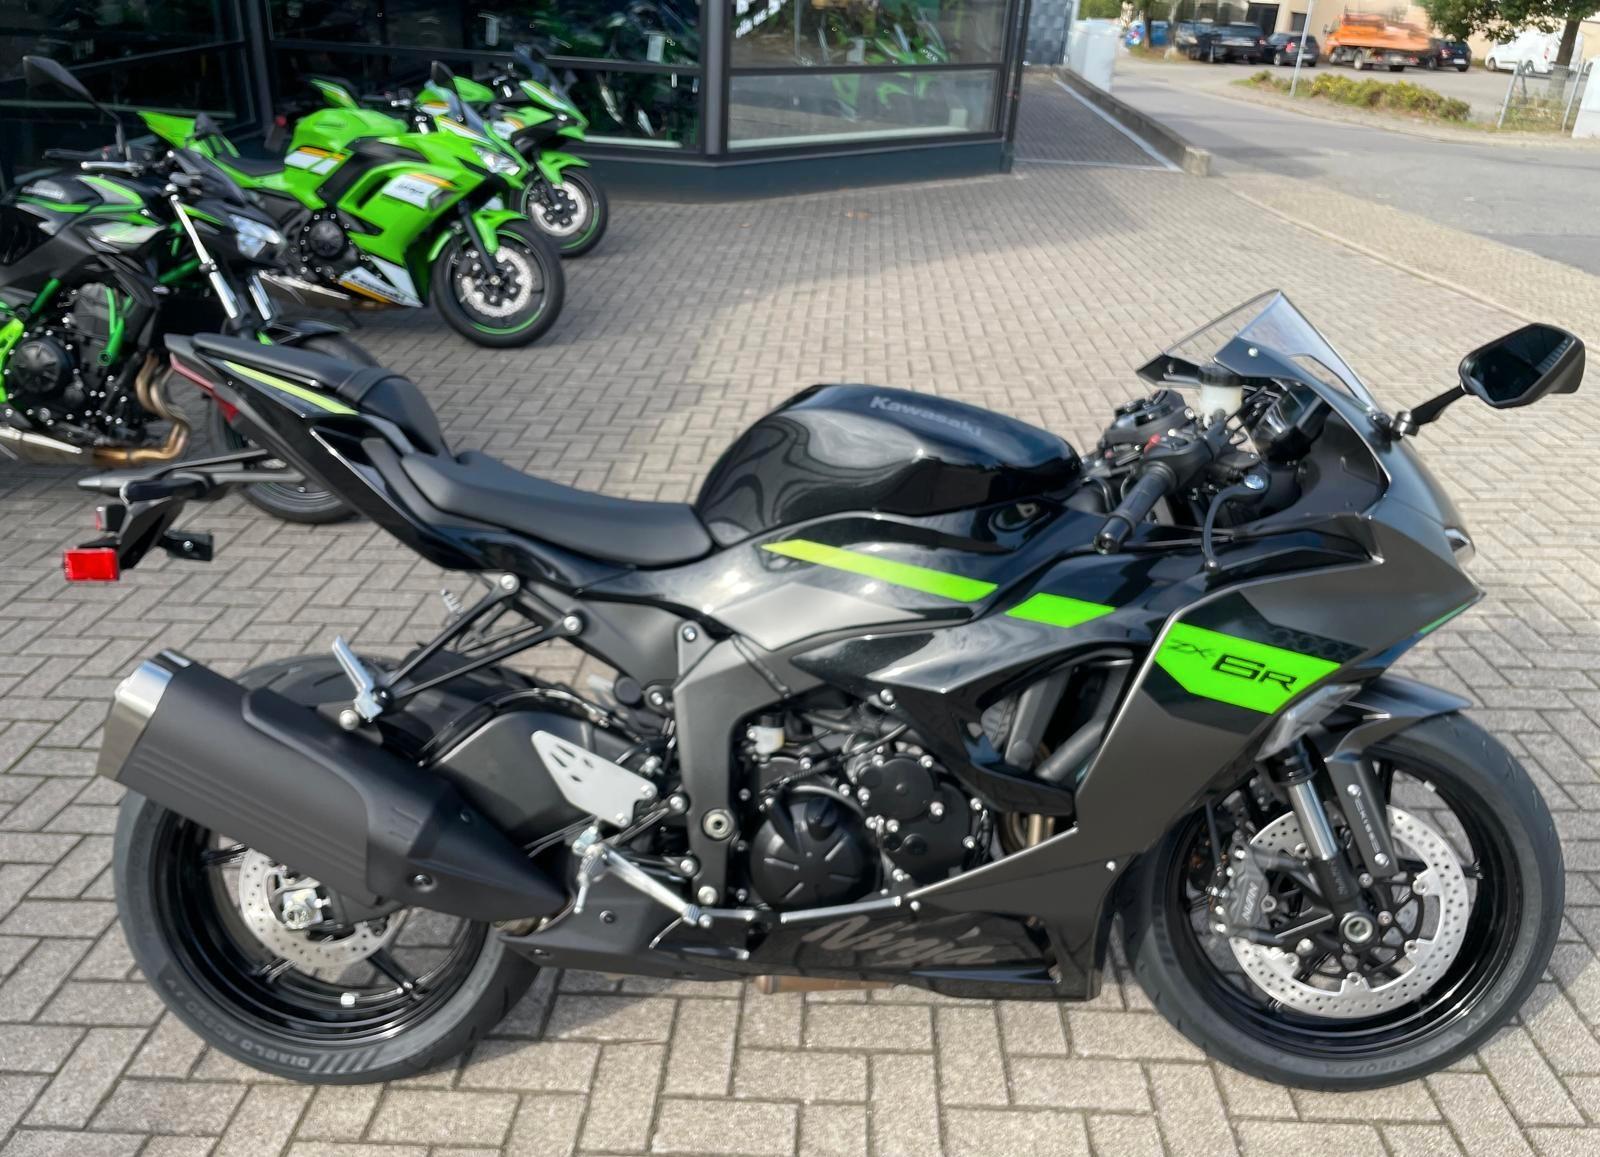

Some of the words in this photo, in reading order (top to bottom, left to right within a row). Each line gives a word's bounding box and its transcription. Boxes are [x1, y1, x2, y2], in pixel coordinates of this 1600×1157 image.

[870, 396, 982, 437] Kawasaki
[801, 912, 996, 967] Ninja
[185, 1001, 238, 1043] ROSSO
[240, 1039, 312, 1068] DIABLO
